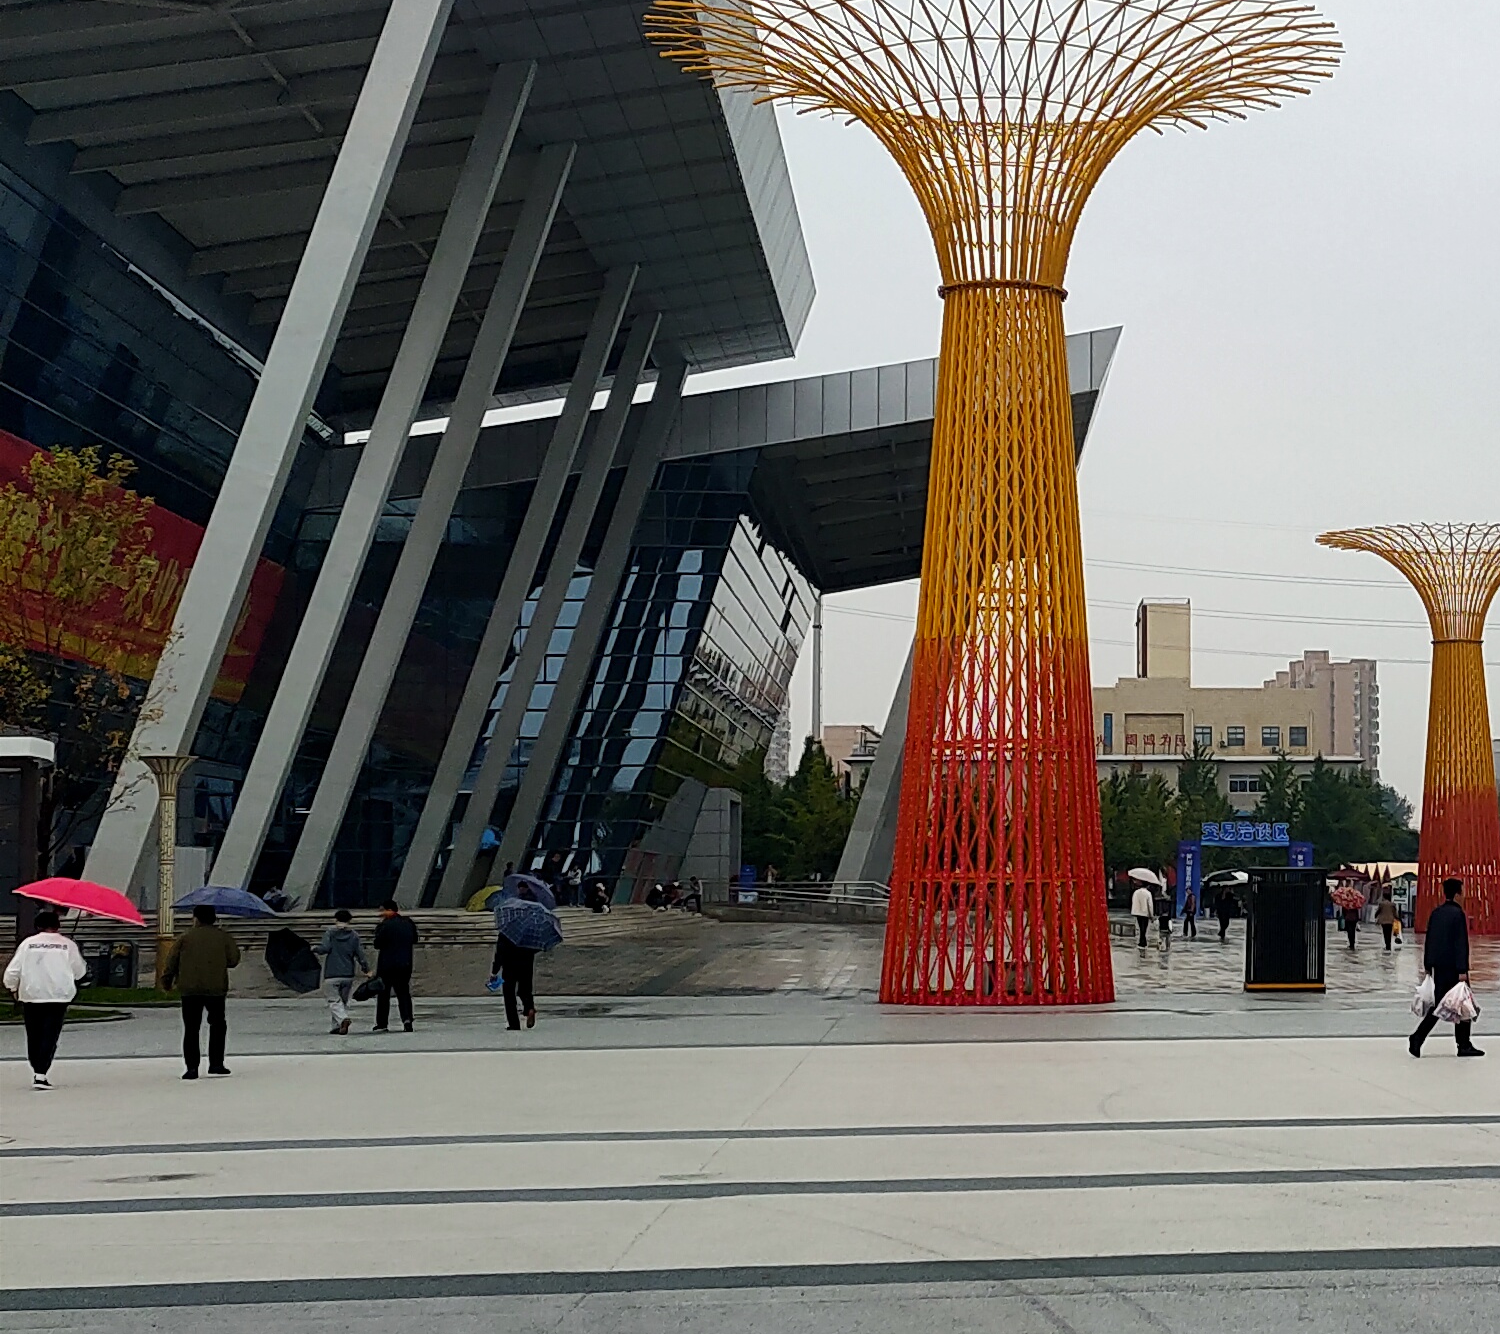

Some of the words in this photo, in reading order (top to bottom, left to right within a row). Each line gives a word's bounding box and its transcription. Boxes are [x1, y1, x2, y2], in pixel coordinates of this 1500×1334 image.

[1202, 821, 1289, 841] 交易洽谈区
